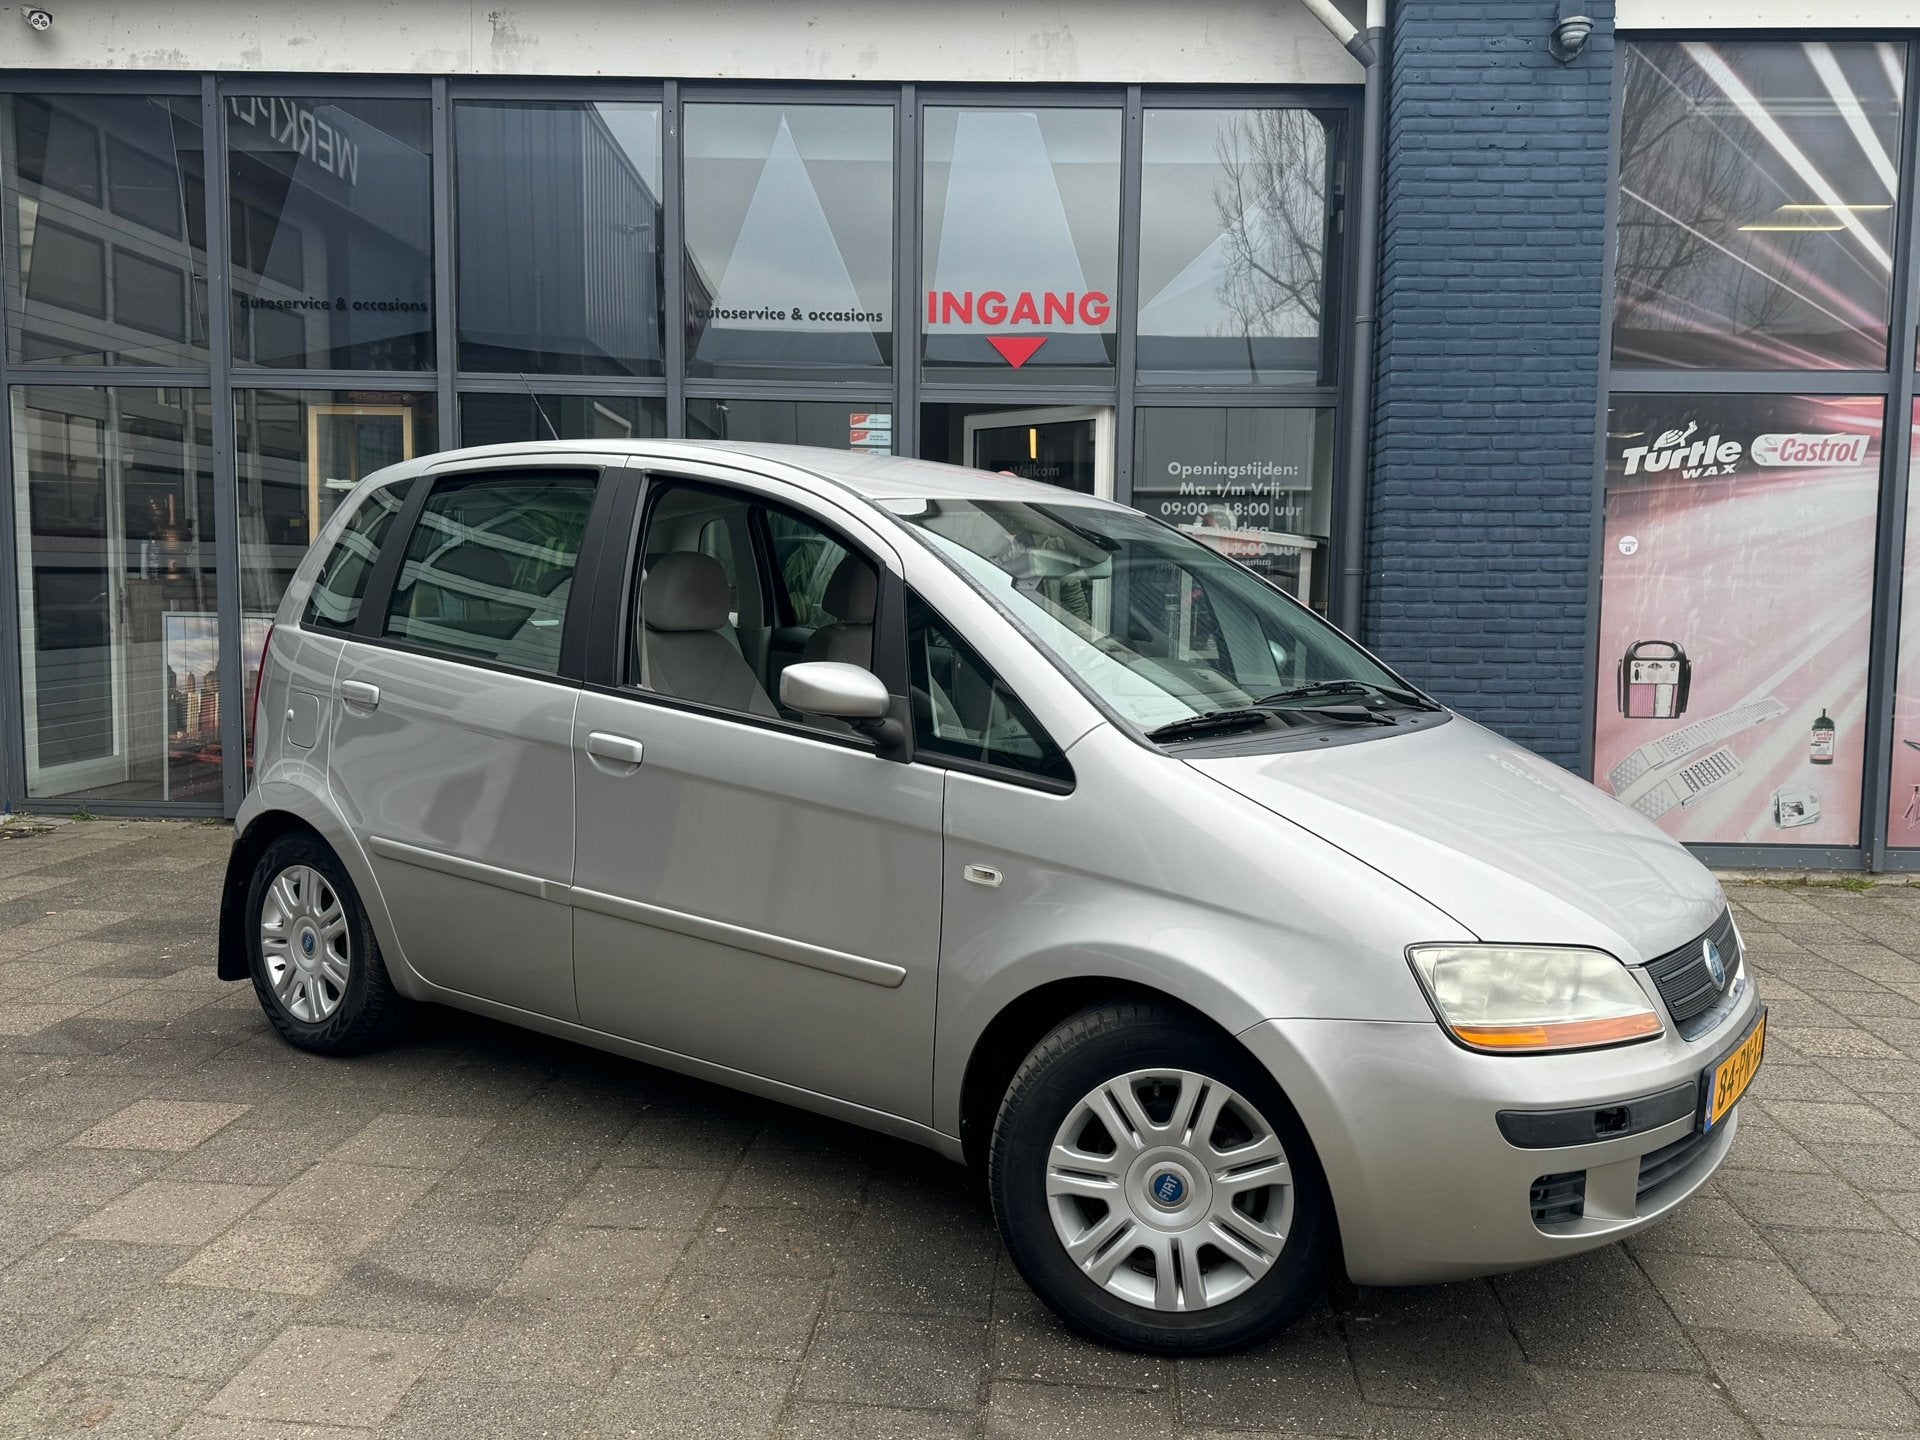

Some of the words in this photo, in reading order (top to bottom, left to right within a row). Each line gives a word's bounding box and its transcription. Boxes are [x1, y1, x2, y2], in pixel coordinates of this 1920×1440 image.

[239, 296, 331, 311] autoservice
[335, 297, 347, 311] &
[352, 298, 428, 312] occasions
[928, 291, 1111, 326] INGANG
[694, 306, 786, 321] autoservice
[790, 307, 803, 321] &
[808, 308, 883, 322] occasions
[1622, 434, 1742, 476] Turtle
[1779, 438, 1859, 462] Castrol
[1009, 464, 1060, 478] Welkom
[1167, 461, 1299, 479] Openingstijden:
[1681, 463, 1737, 480] WAX
[1179, 482, 1211, 496] Ma.
[1216, 481, 1246, 498] t/m
[1251, 482, 1285, 500] Vrij.
[1160, 502, 1208, 516] 09:00
[1274, 506, 1303, 516] uur
[1273, 546, 1302, 556] uur
[1158, 1175, 1178, 1201] FIAT
